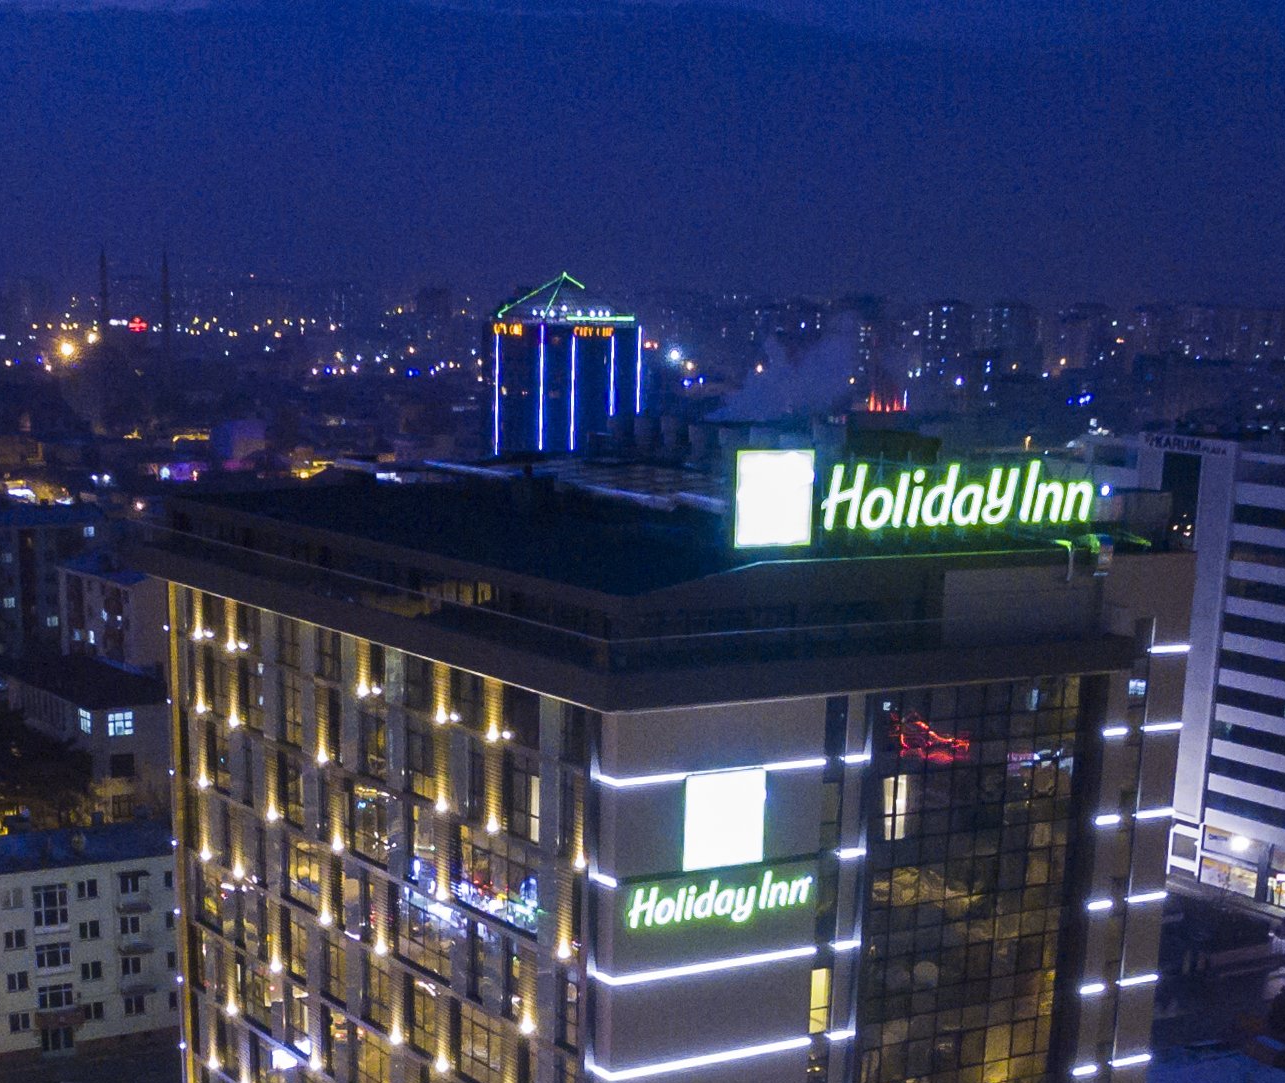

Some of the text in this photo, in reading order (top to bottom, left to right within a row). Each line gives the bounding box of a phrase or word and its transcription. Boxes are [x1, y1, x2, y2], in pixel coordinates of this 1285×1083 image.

[821, 460, 1094, 531] Holiday Inn
[627, 870, 813, 929] Holiday Inn
